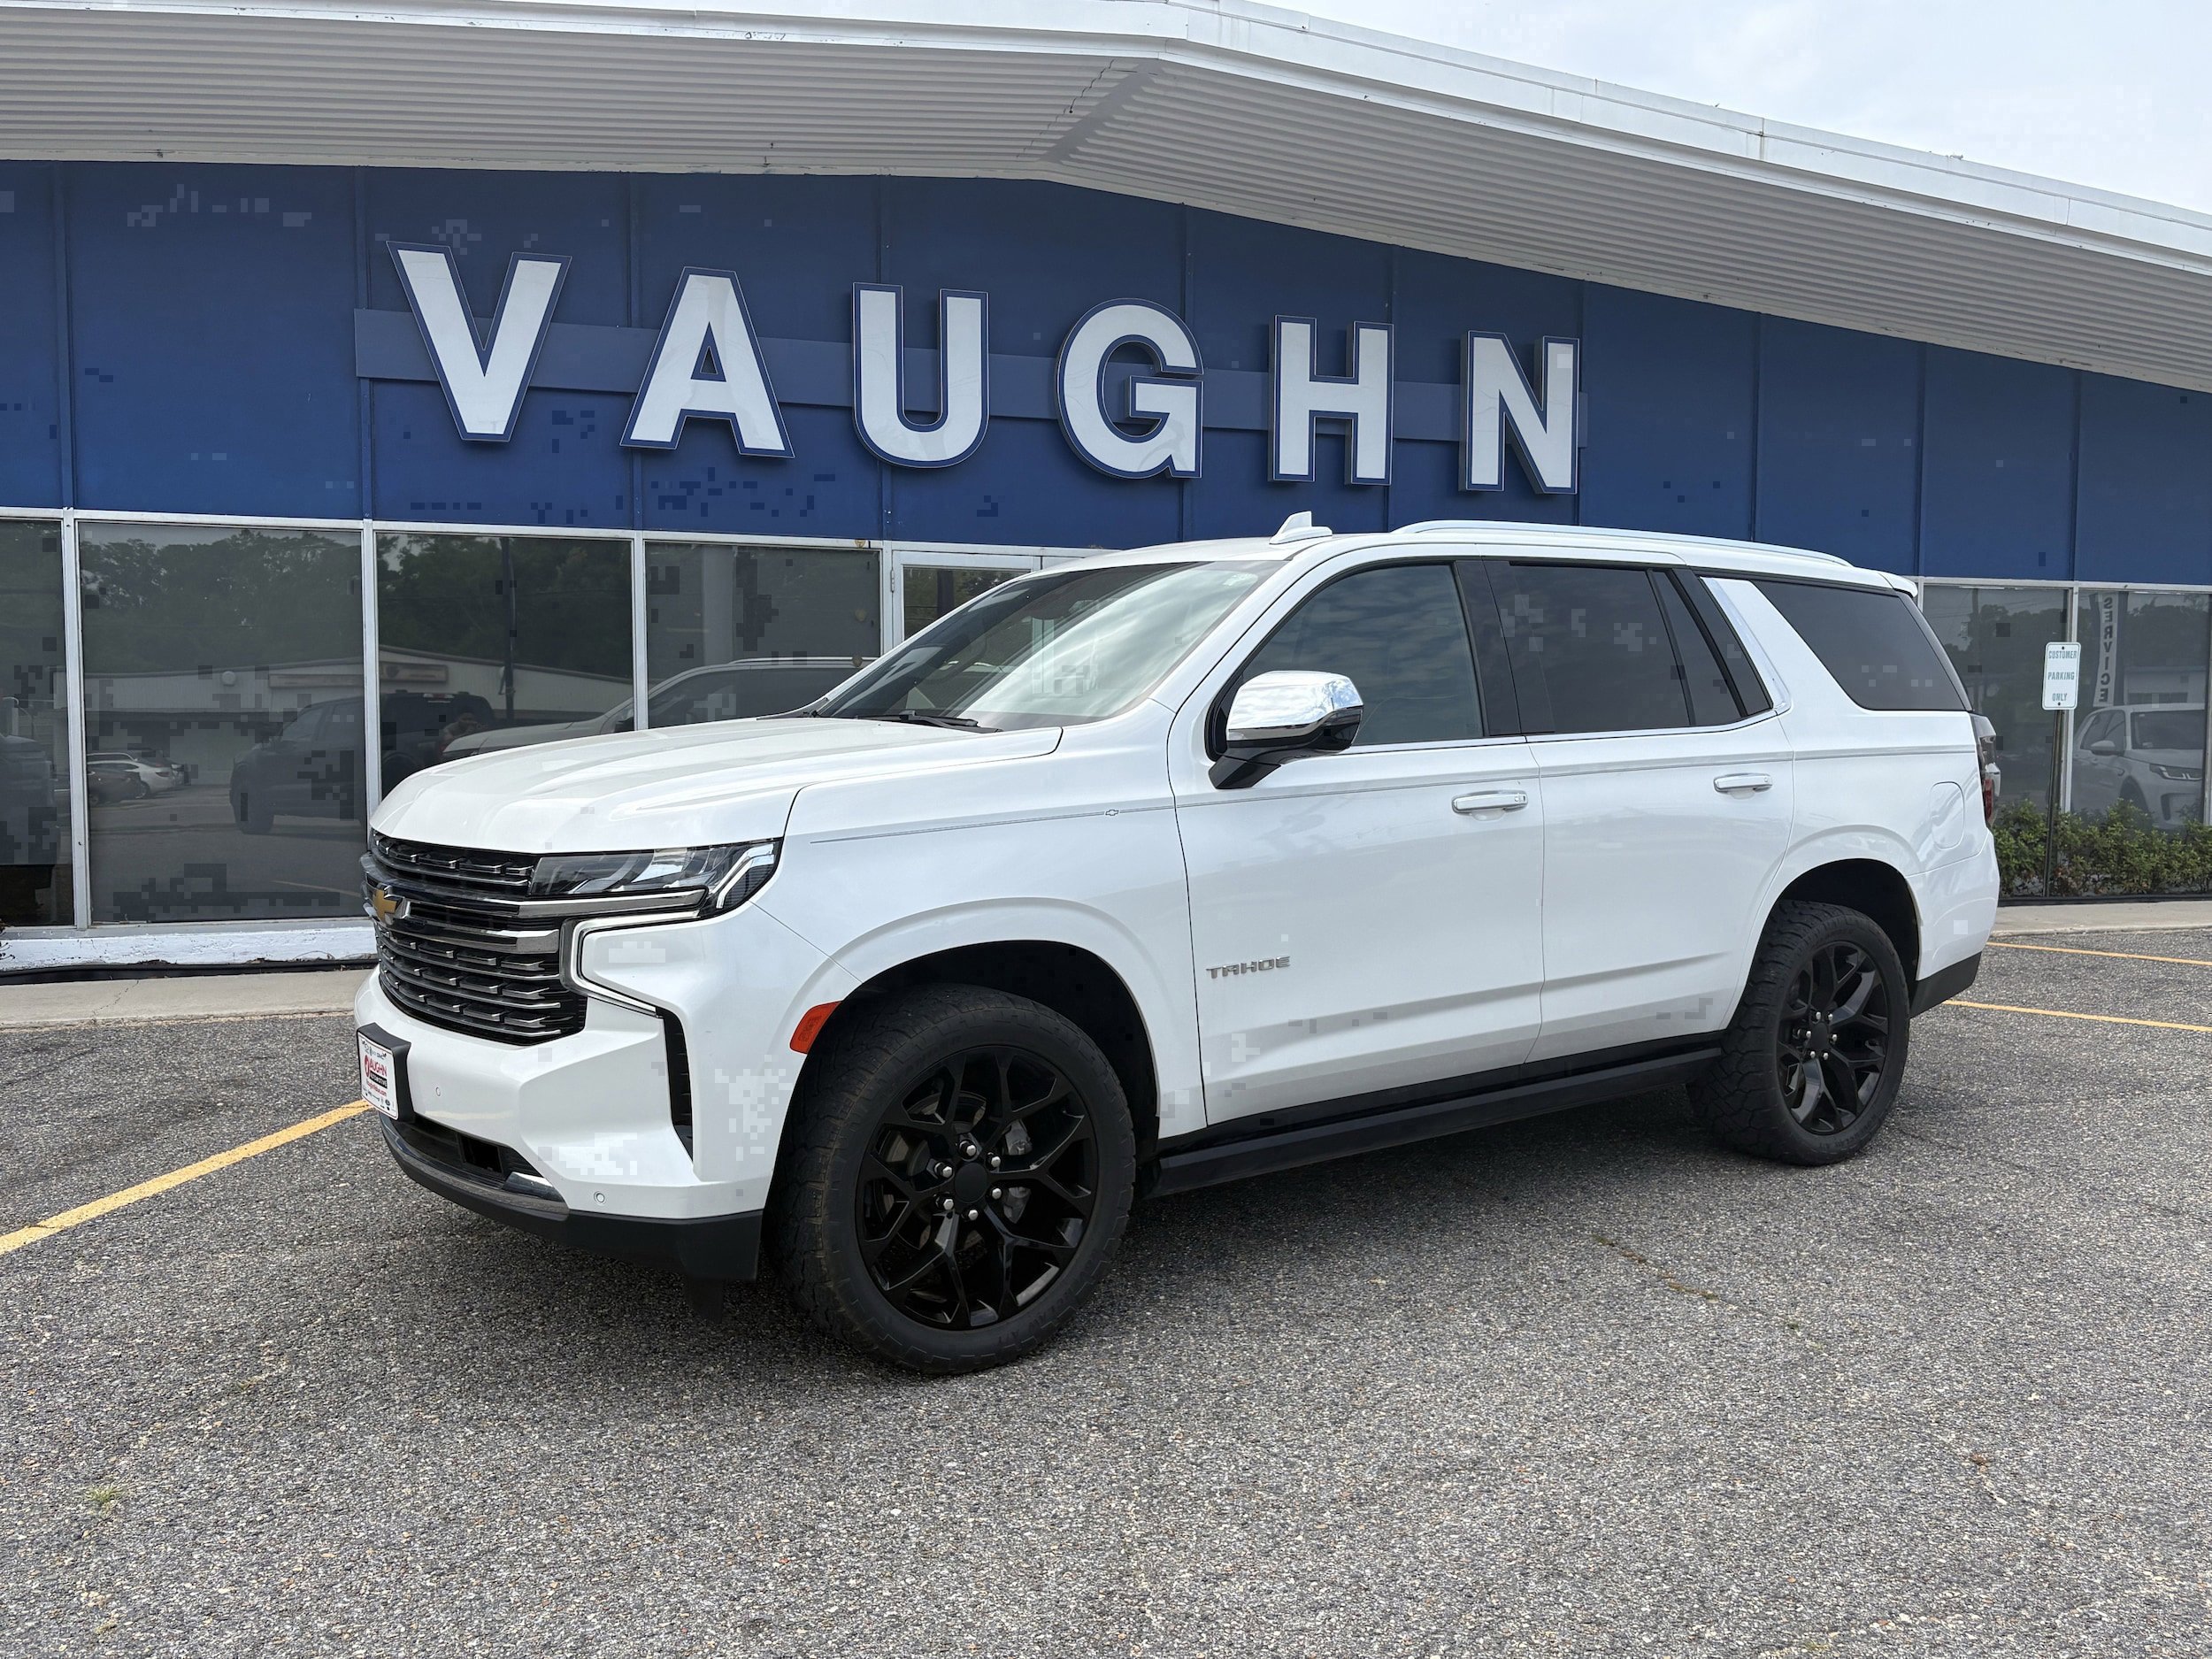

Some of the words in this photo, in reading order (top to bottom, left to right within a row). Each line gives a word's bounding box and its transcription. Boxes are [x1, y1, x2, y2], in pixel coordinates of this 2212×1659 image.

[388, 242, 1579, 494] VAUGHN
[2048, 650, 2078, 659] CUSTOMER
[2047, 672, 2075, 680] PARKING
[2052, 693, 2068, 702] ONLY
[1205, 956, 1290, 979] TAHOE
